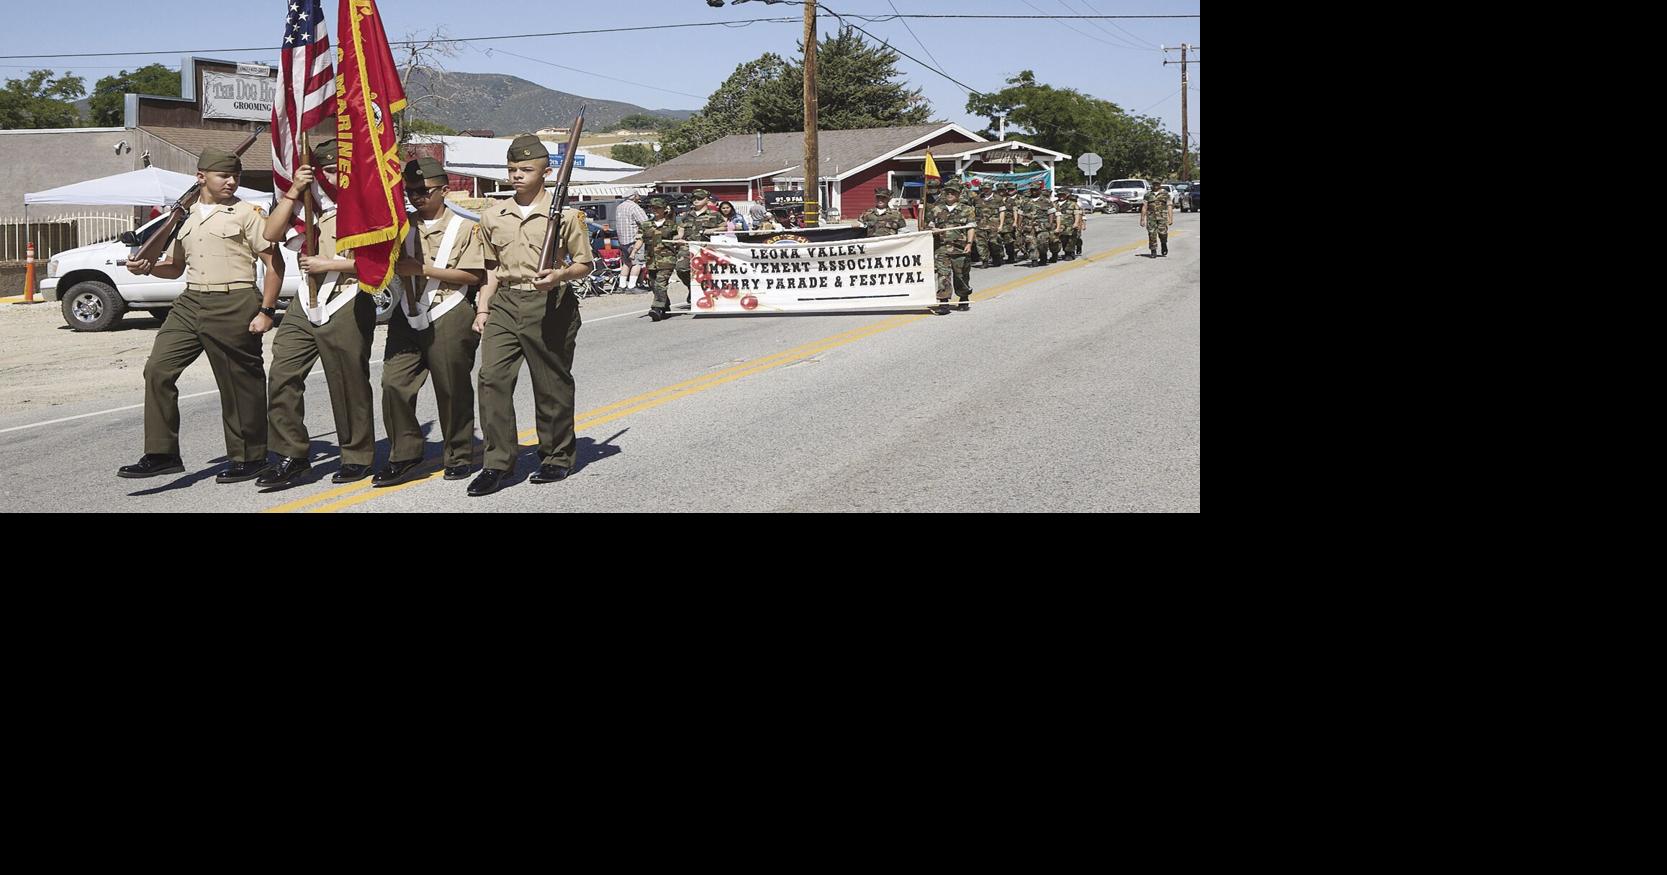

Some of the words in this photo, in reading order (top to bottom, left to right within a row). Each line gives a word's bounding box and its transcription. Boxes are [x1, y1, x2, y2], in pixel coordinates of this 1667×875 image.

[233, 101, 272, 112] GROOMING
[336, 73, 353, 189] MARINES
[750, 248, 801, 260] LEONA
[807, 245, 866, 258] VALLEY
[703, 262, 811, 275] IMPROVEMENT
[818, 254, 922, 272] ASSOCIATION
[700, 278, 760, 291] CHERRY
[766, 276, 828, 290] PARADE
[834, 275, 842, 288] &
[849, 271, 925, 287] FESTIVAL
